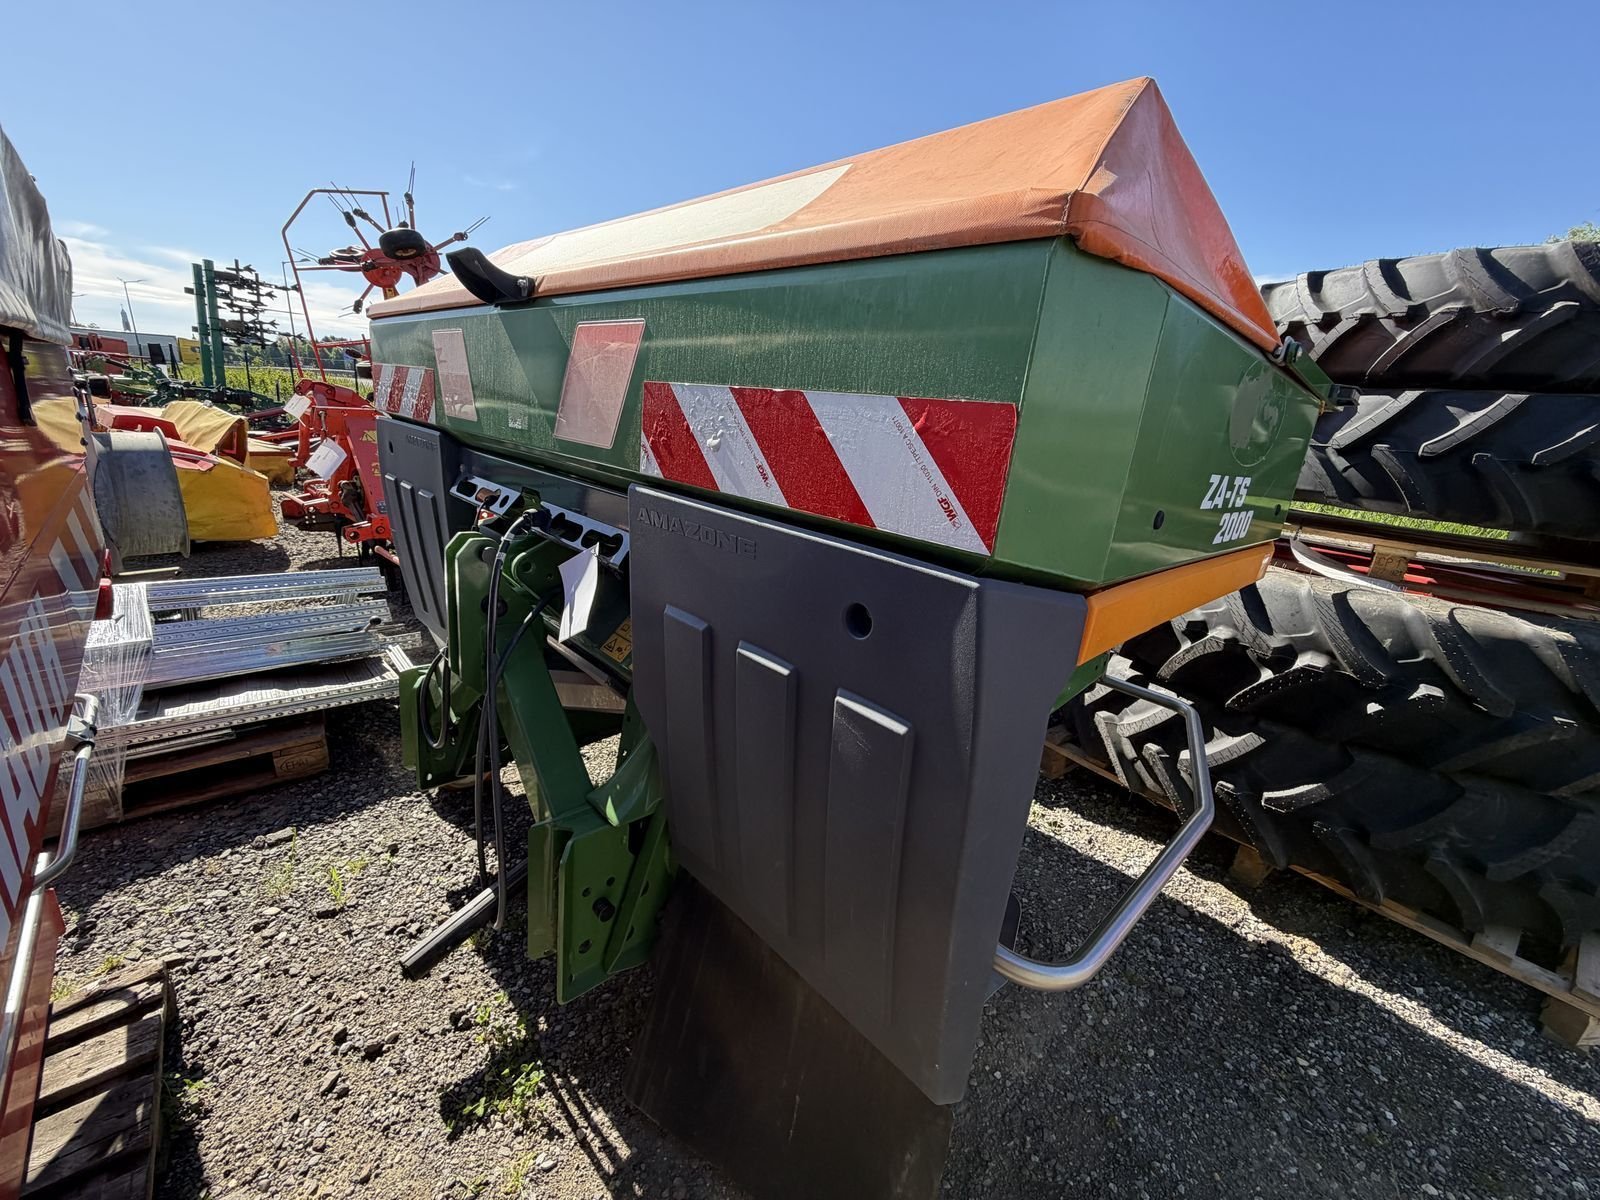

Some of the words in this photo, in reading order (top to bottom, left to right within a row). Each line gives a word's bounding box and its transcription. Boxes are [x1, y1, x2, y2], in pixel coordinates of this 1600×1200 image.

[891, 415, 905, 434] 10071
[920, 464, 934, 484] 11030
[931, 483, 943, 497] DIN
[1200, 474, 1252, 509] ZA-TS
[937, 494, 958, 522] WGF
[637, 507, 757, 560] AMAZONE
[1212, 510, 1254, 545] 2000
